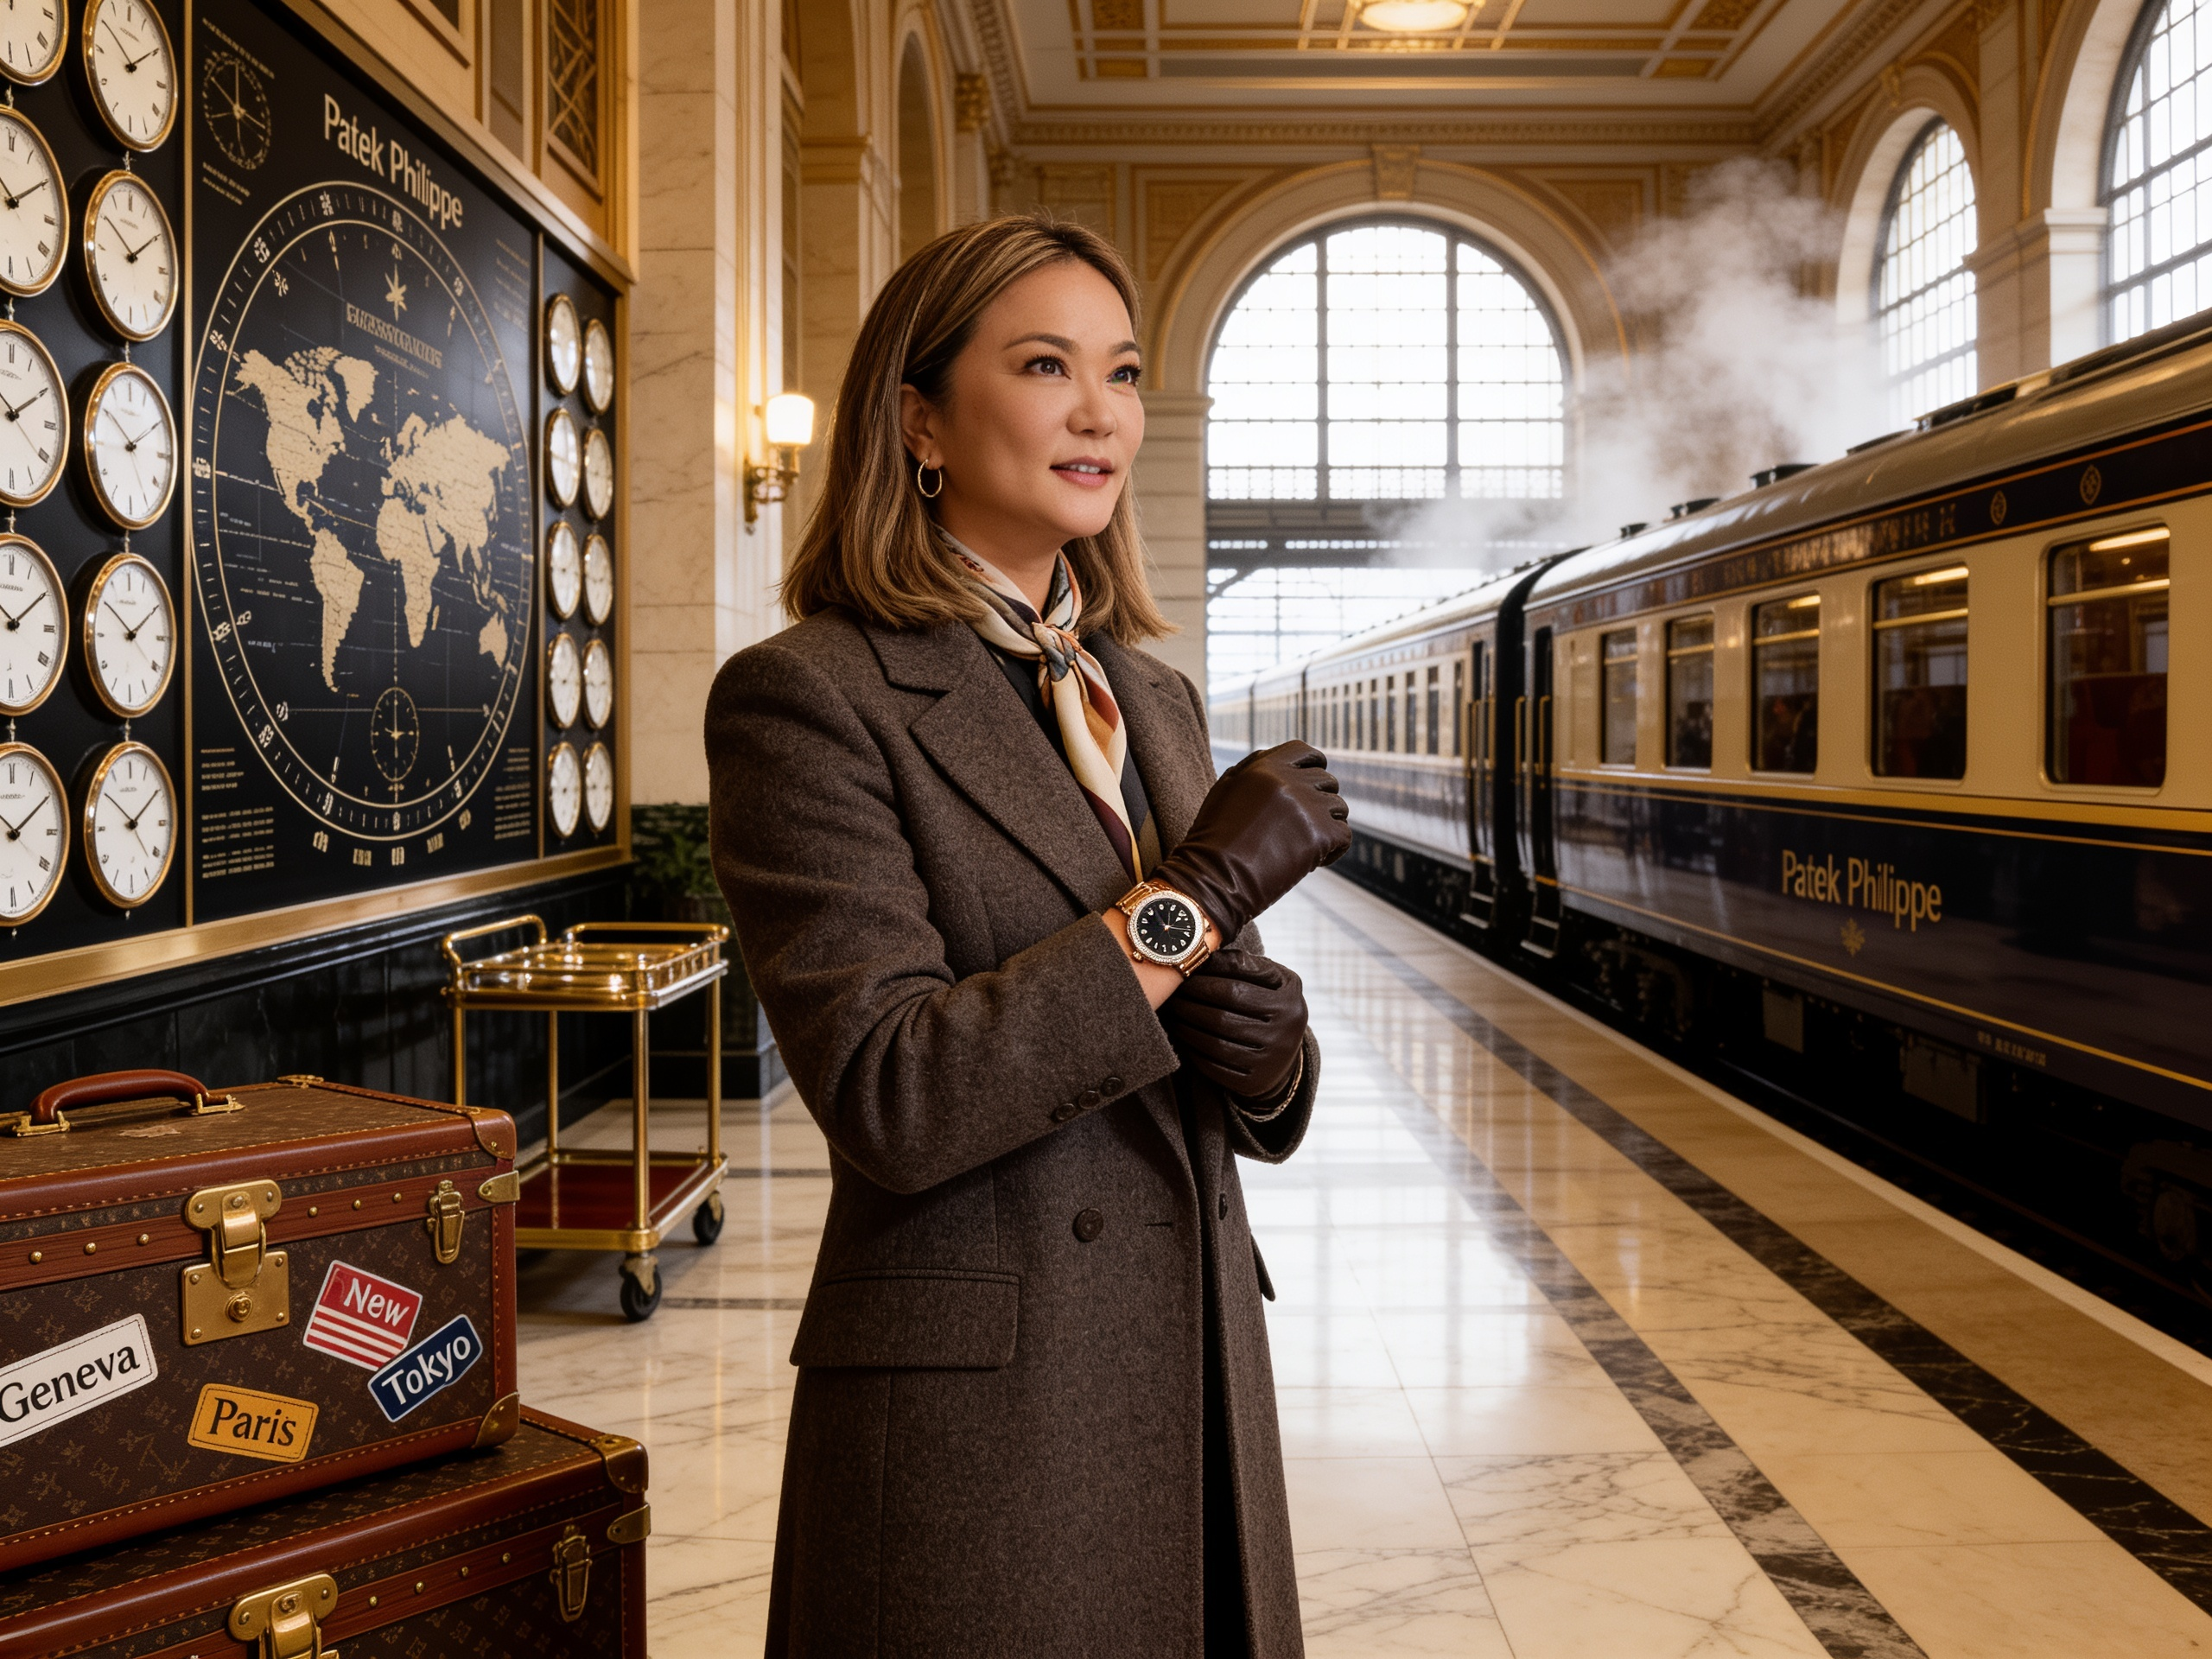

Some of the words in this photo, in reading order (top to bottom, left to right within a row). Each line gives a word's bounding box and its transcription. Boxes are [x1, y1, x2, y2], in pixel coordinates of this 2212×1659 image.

[324, 93, 385, 177] Patek
[391, 139, 463, 231] Philippe
[1782, 849, 1841, 905] Patek
[1847, 856, 1942, 932] Philippe
[343, 1277, 410, 1327] New
[0, 1345, 141, 1423] Geneva
[381, 1335, 472, 1405] Tokyo
[207, 1397, 296, 1447] Paris
